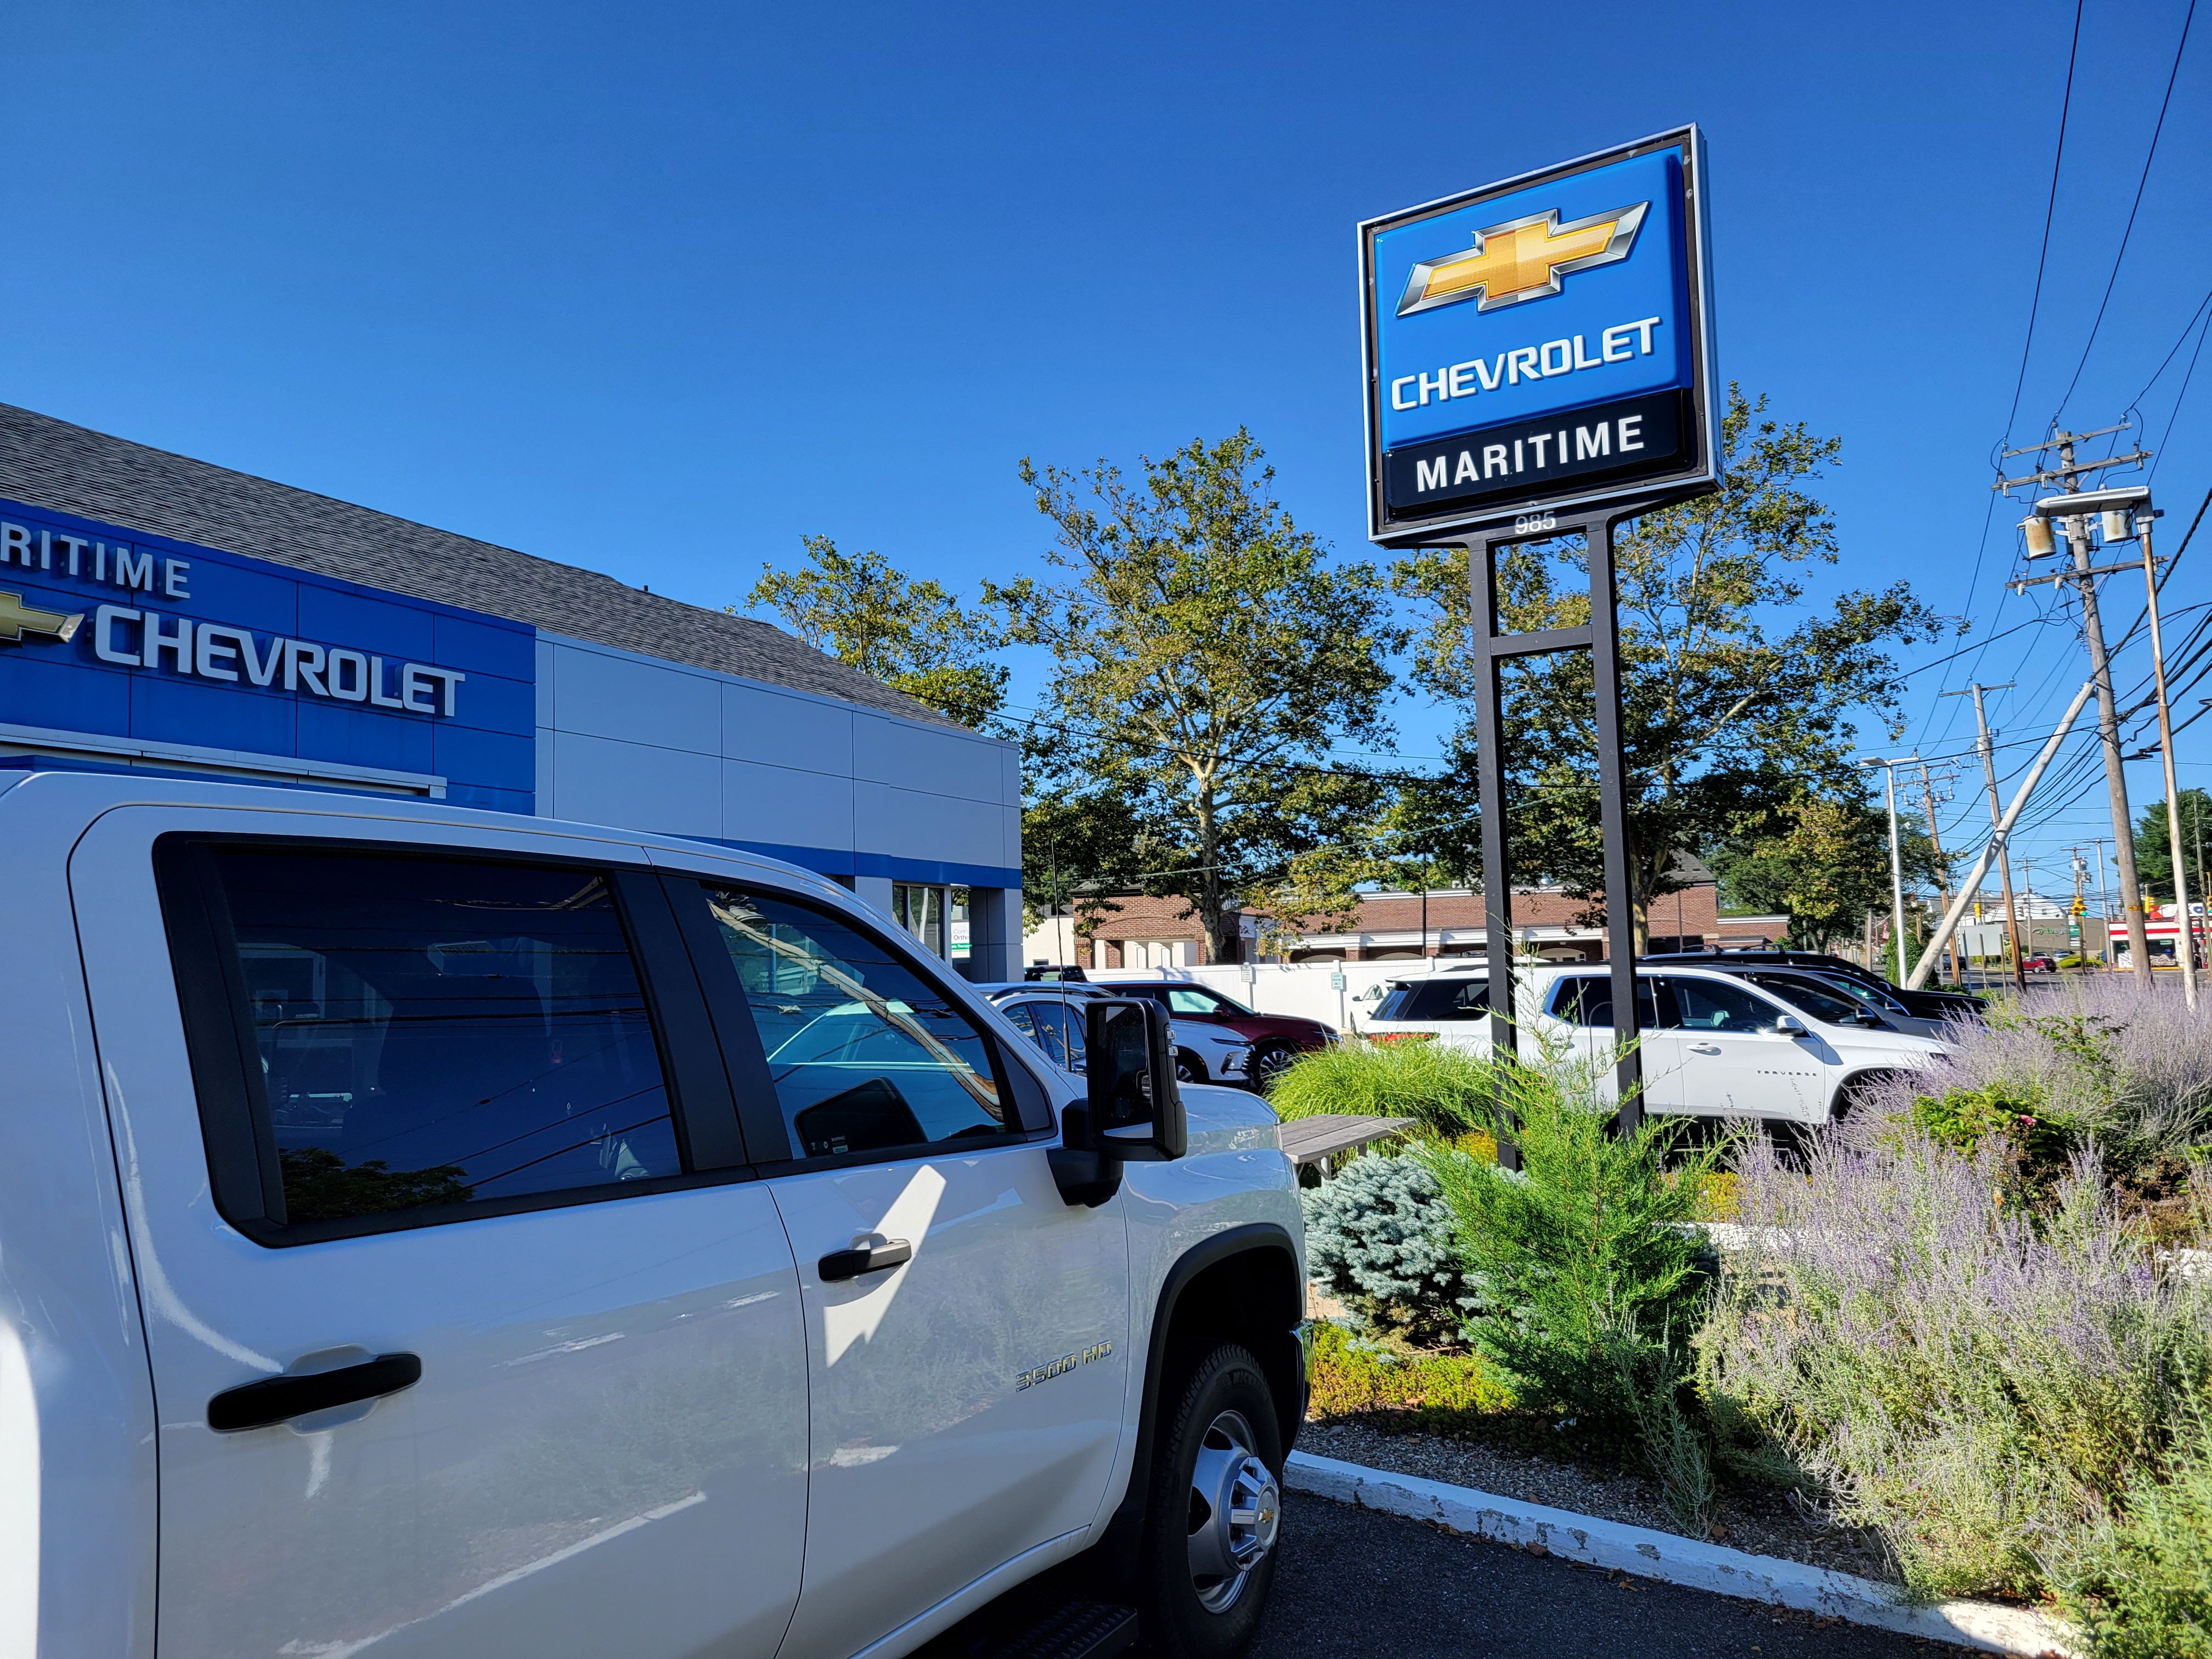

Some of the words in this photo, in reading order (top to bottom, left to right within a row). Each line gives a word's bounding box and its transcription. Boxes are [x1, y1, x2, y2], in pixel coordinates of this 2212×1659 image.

[1391, 316, 1661, 410] CHEVROLET
[1417, 415, 1645, 492] MARITIME
[0, 521, 191, 599] RITIME
[1515, 510, 1555, 534] 985
[95, 604, 465, 717] CHEVROLET
[1016, 1353, 1077, 1392] 3500
[1082, 1339, 1111, 1365] HD
